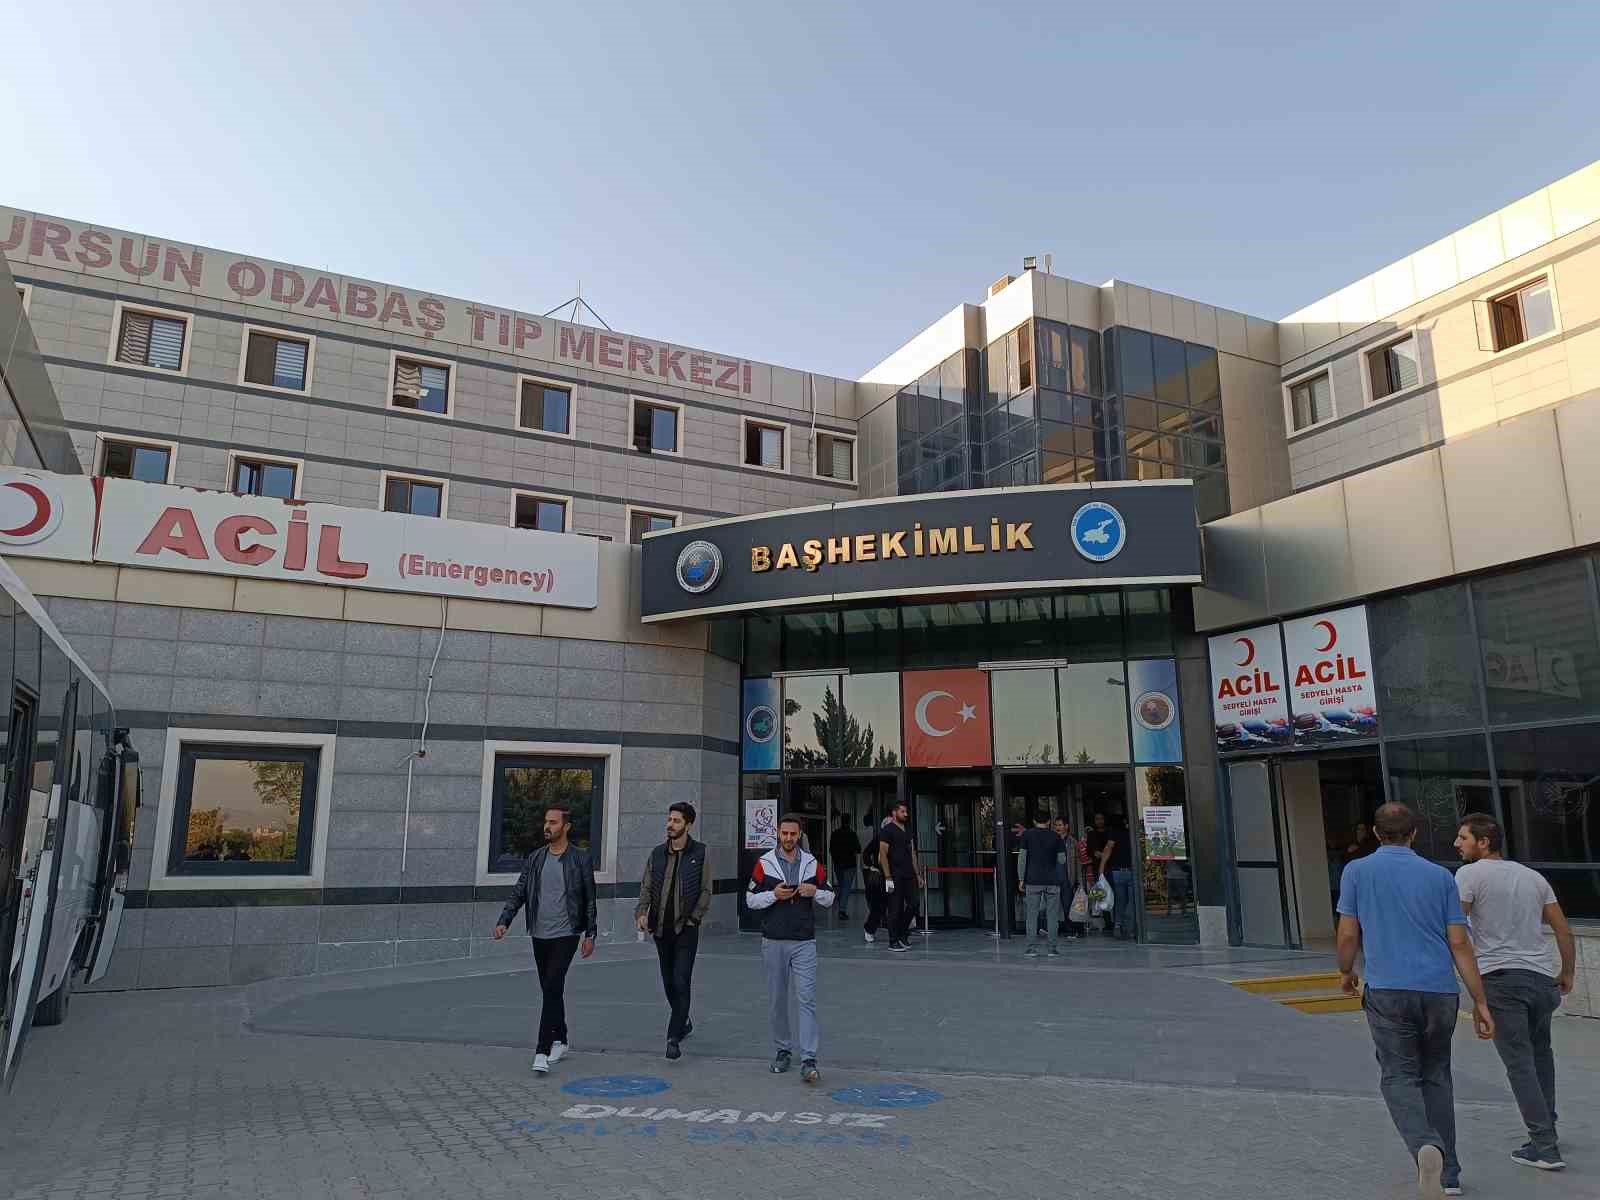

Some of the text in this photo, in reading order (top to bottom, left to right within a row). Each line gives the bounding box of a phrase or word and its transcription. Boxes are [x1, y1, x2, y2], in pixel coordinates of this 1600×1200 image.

[226, 260, 446, 337] ODABAŞ
[467, 306, 543, 350] TIP
[135, 506, 554, 593] ACİL (Emergency)
[750, 516, 1036, 573] BAŞHEKİMLİK
[1218, 667, 1280, 699] ACİL
[1294, 653, 1367, 687] ACİL
[1252, 697, 1278, 707] HASTA
[1335, 684, 1363, 695] HASTA
